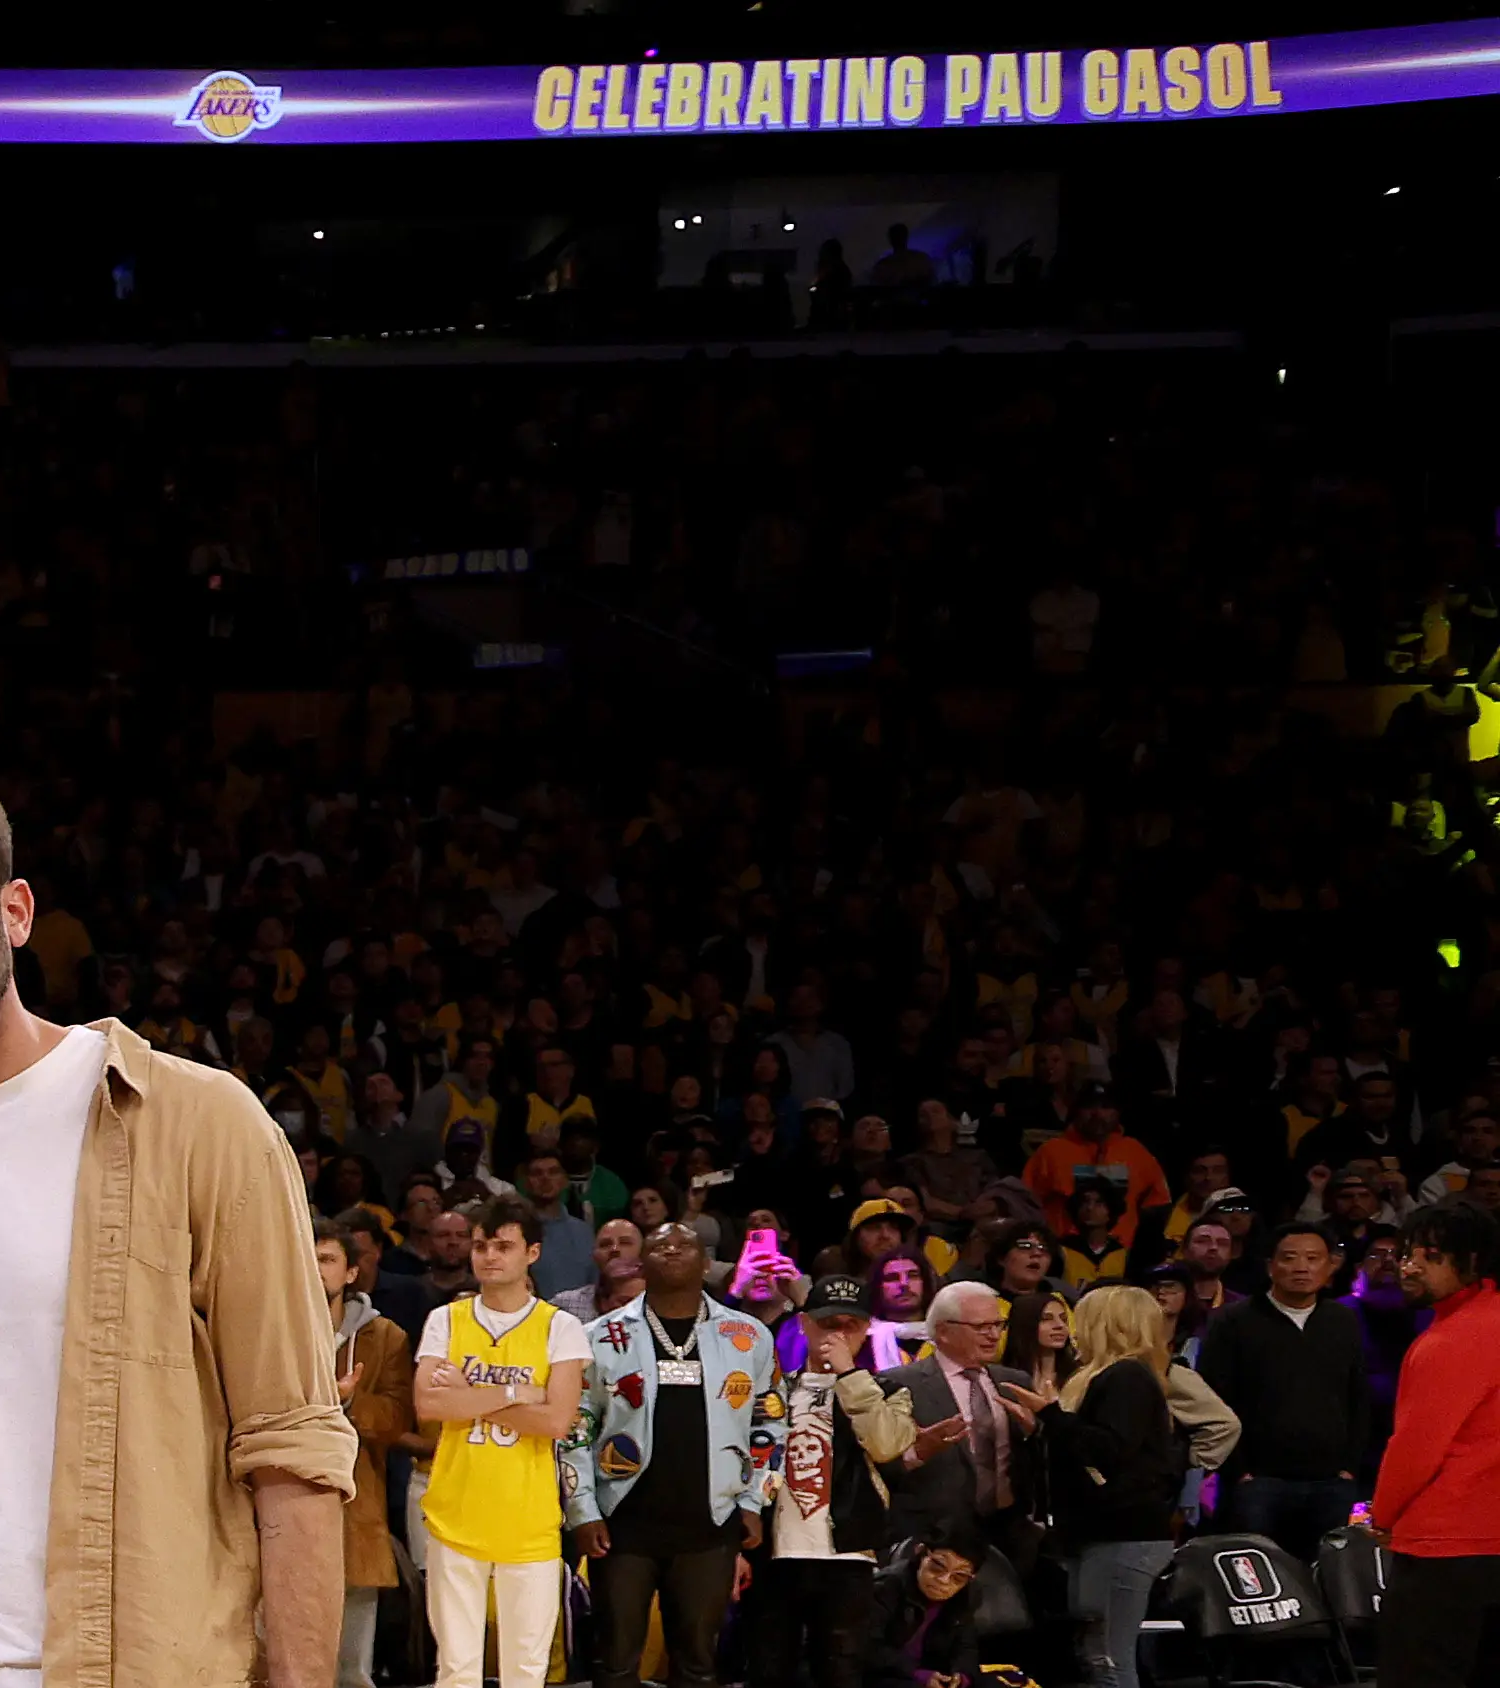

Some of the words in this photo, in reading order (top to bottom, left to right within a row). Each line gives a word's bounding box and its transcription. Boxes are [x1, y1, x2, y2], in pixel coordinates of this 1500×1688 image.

[534, 53, 926, 131] CELEBRATING
[946, 49, 1062, 119] PAU
[1083, 39, 1283, 116] GASOL
[185, 88, 274, 123] LAKERS
[461, 1355, 536, 1388] LAKERS
[1228, 1604, 1251, 1626] GET
[1249, 1602, 1277, 1624] THE
[1272, 1597, 1302, 1621] APP
